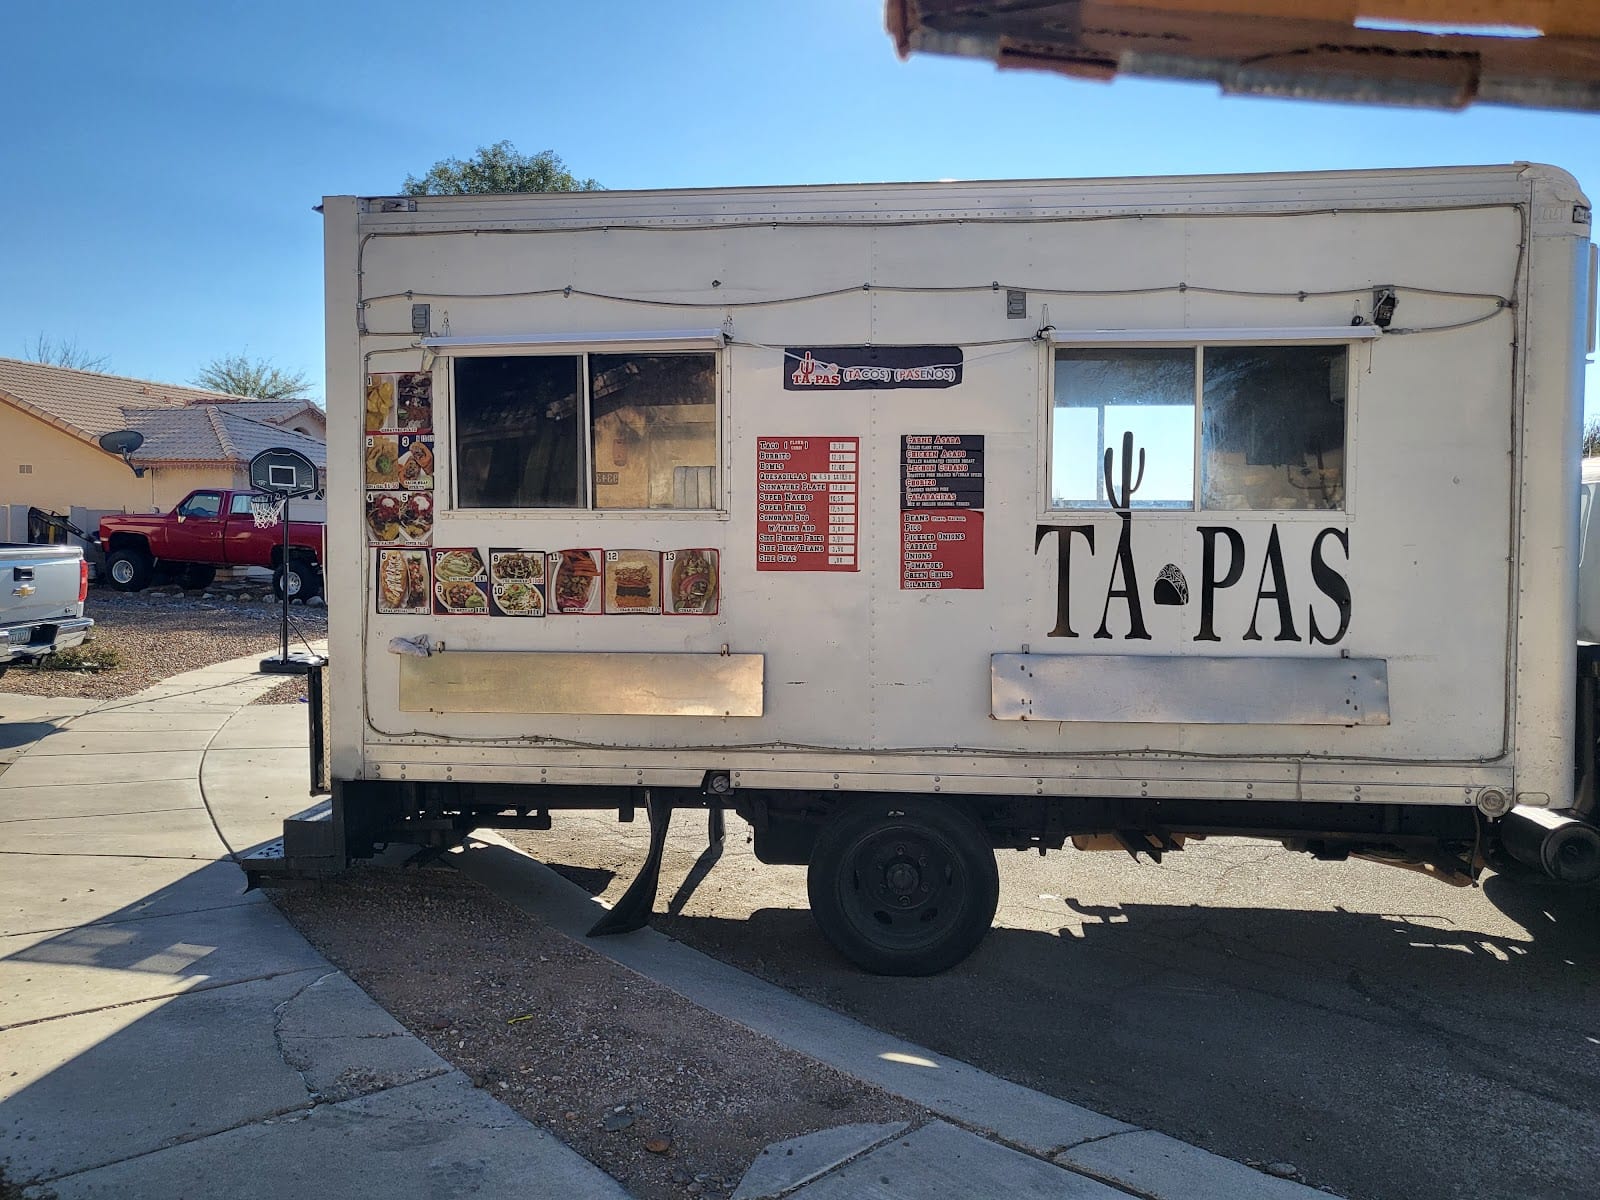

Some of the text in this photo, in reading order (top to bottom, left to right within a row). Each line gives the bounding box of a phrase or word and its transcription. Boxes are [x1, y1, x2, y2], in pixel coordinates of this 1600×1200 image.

[367, 377, 372, 386] 1
[367, 438, 373, 446] 2
[403, 438, 408, 446] 3
[906, 435, 961, 444] CARNE ASADA
[760, 441, 779, 449] TACO
[760, 452, 791, 460] BURRITO
[906, 450, 938, 459] CHICKEN
[906, 464, 969, 473] LECHON CUBANO
[905, 478, 937, 487] CHORIZO
[367, 493, 373, 501] 4
[402, 493, 408, 501] 5
[759, 493, 782, 501] SUPER
[785, 493, 813, 501] NACHOS
[906, 493, 957, 502] CALABACITAS
[795, 513, 809, 521] DOG
[904, 513, 929, 522] BEANS
[904, 524, 922, 532] PICO
[904, 532, 965, 542] PICKLED ONIONS
[904, 542, 937, 550] CABBAGE
[381, 552, 386, 560] 6
[438, 553, 443, 561] 7
[493, 554, 499, 562] 8
[550, 553, 558, 561] 11
[608, 553, 617, 561] 12
[666, 553, 675, 561] 13
[904, 552, 932, 560] ONIONS
[904, 562, 943, 570] TOMATOES
[904, 571, 928, 579] GREEN
[904, 580, 941, 588] CILANTRO
[494, 587, 503, 595] 10
